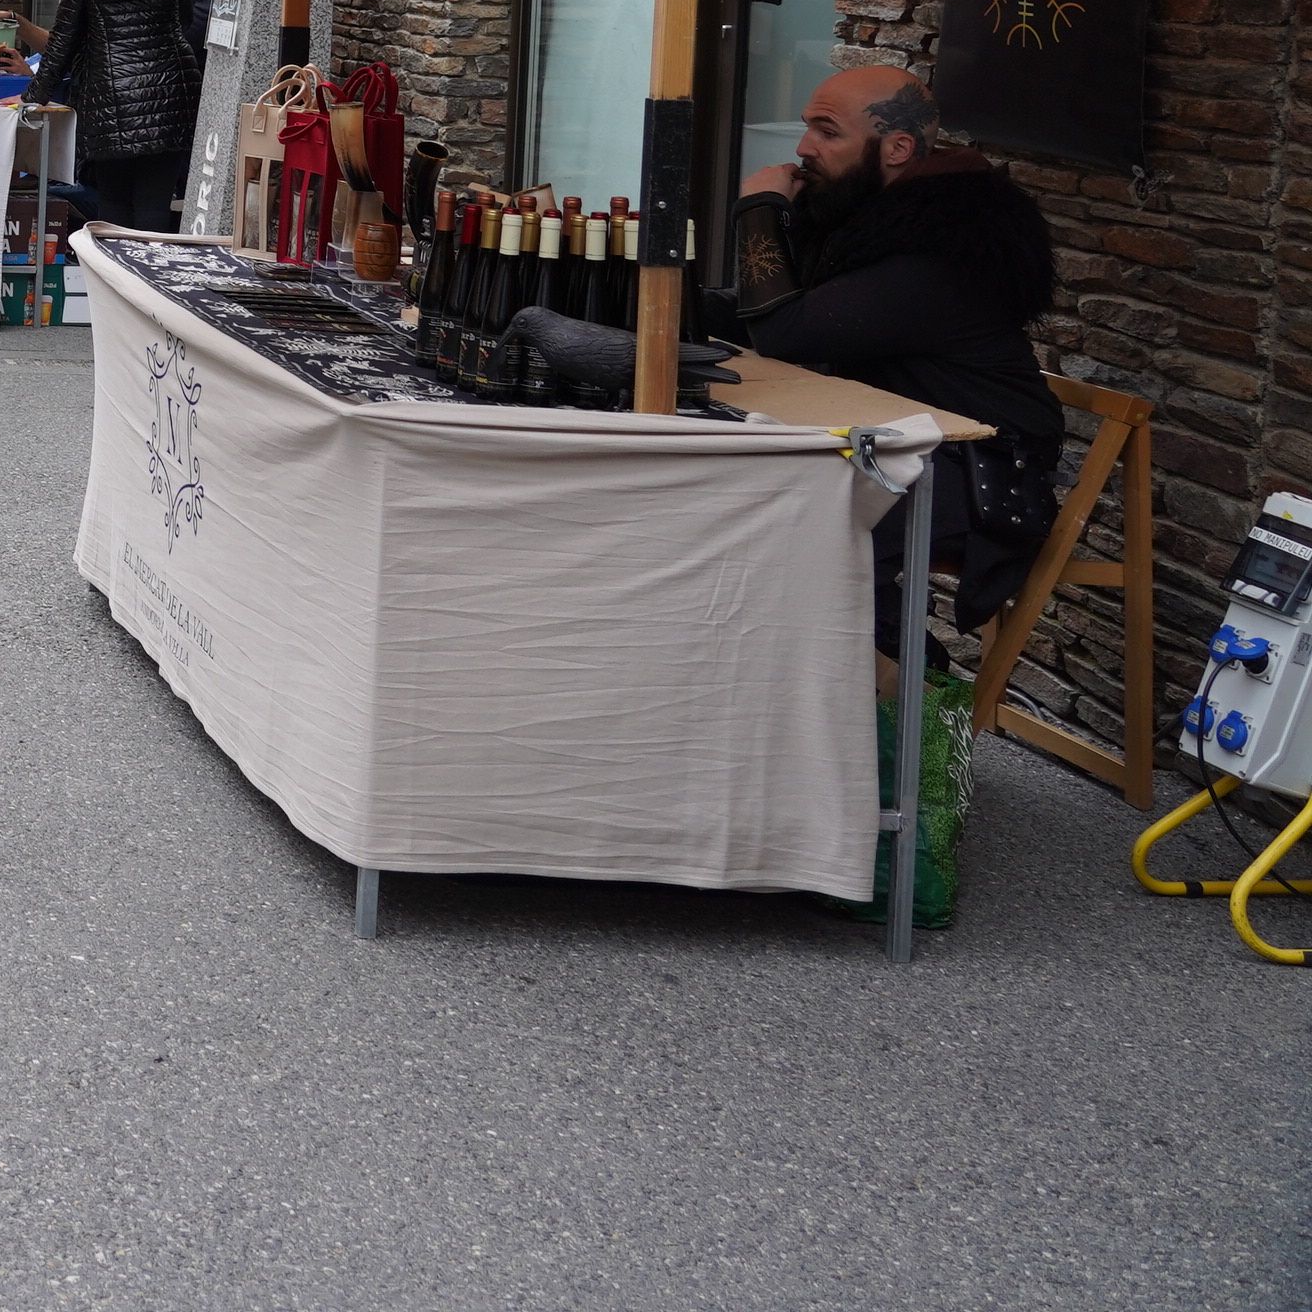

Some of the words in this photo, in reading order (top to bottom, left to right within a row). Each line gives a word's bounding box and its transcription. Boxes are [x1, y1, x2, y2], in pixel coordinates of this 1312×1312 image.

[1250, 528, 1263, 539] NO
[1264, 532, 1312, 558] MANIPULEU
[124, 542, 133, 570] EL
[177, 603, 190, 634] LA
[193, 615, 214, 660] VALL
